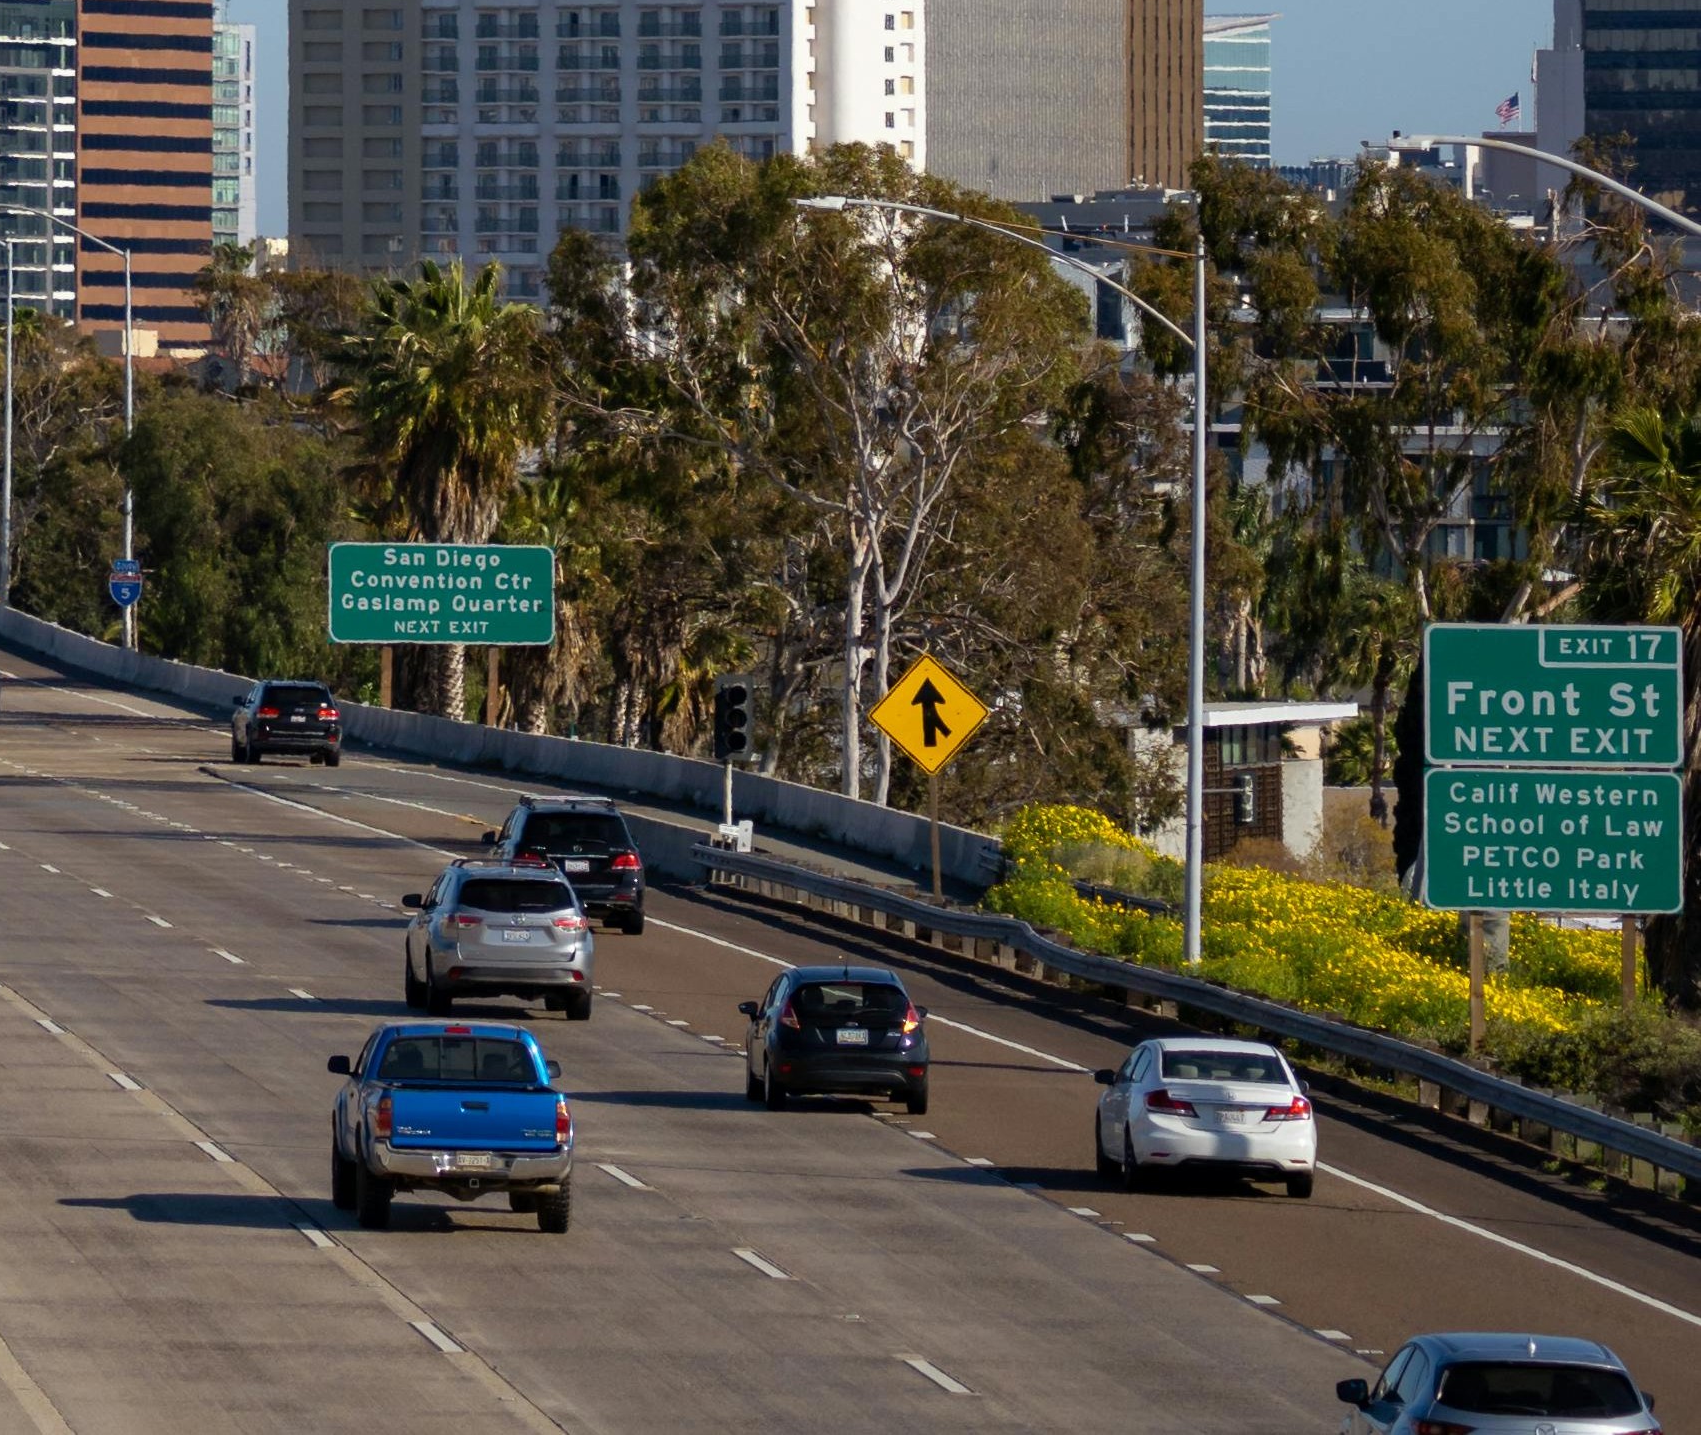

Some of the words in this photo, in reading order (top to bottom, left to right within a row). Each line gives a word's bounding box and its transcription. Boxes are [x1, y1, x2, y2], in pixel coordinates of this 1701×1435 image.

[384, 548, 425, 566] San
[437, 550, 500, 571] Diego
[351, 571, 482, 589] Convention
[495, 573, 532, 590] Ctr
[121, 588, 130, 599] 5
[342, 594, 440, 614] Gaslamp
[452, 595, 542, 613] Quarter
[394, 620, 440, 633] NEXT
[449, 622, 489, 634] EXIT
[1560, 638, 1613, 655] EXIT
[1628, 635, 1662, 660] 17
[1447, 681, 1581, 716] Front
[1609, 682, 1660, 717] St
[1455, 727, 1554, 753] NEXT
[1571, 728, 1653, 754] EXIT
[1450, 782, 1518, 804] Calif
[1535, 783, 1658, 806] Western
[1444, 813, 1543, 834] School
[1560, 815, 1589, 835] of
[1605, 815, 1663, 837] Law
[1463, 846, 1560, 868] PETCO
[1577, 848, 1644, 870] Park
[1467, 876, 1552, 898] Little
[1568, 879, 1639, 907] Italy
